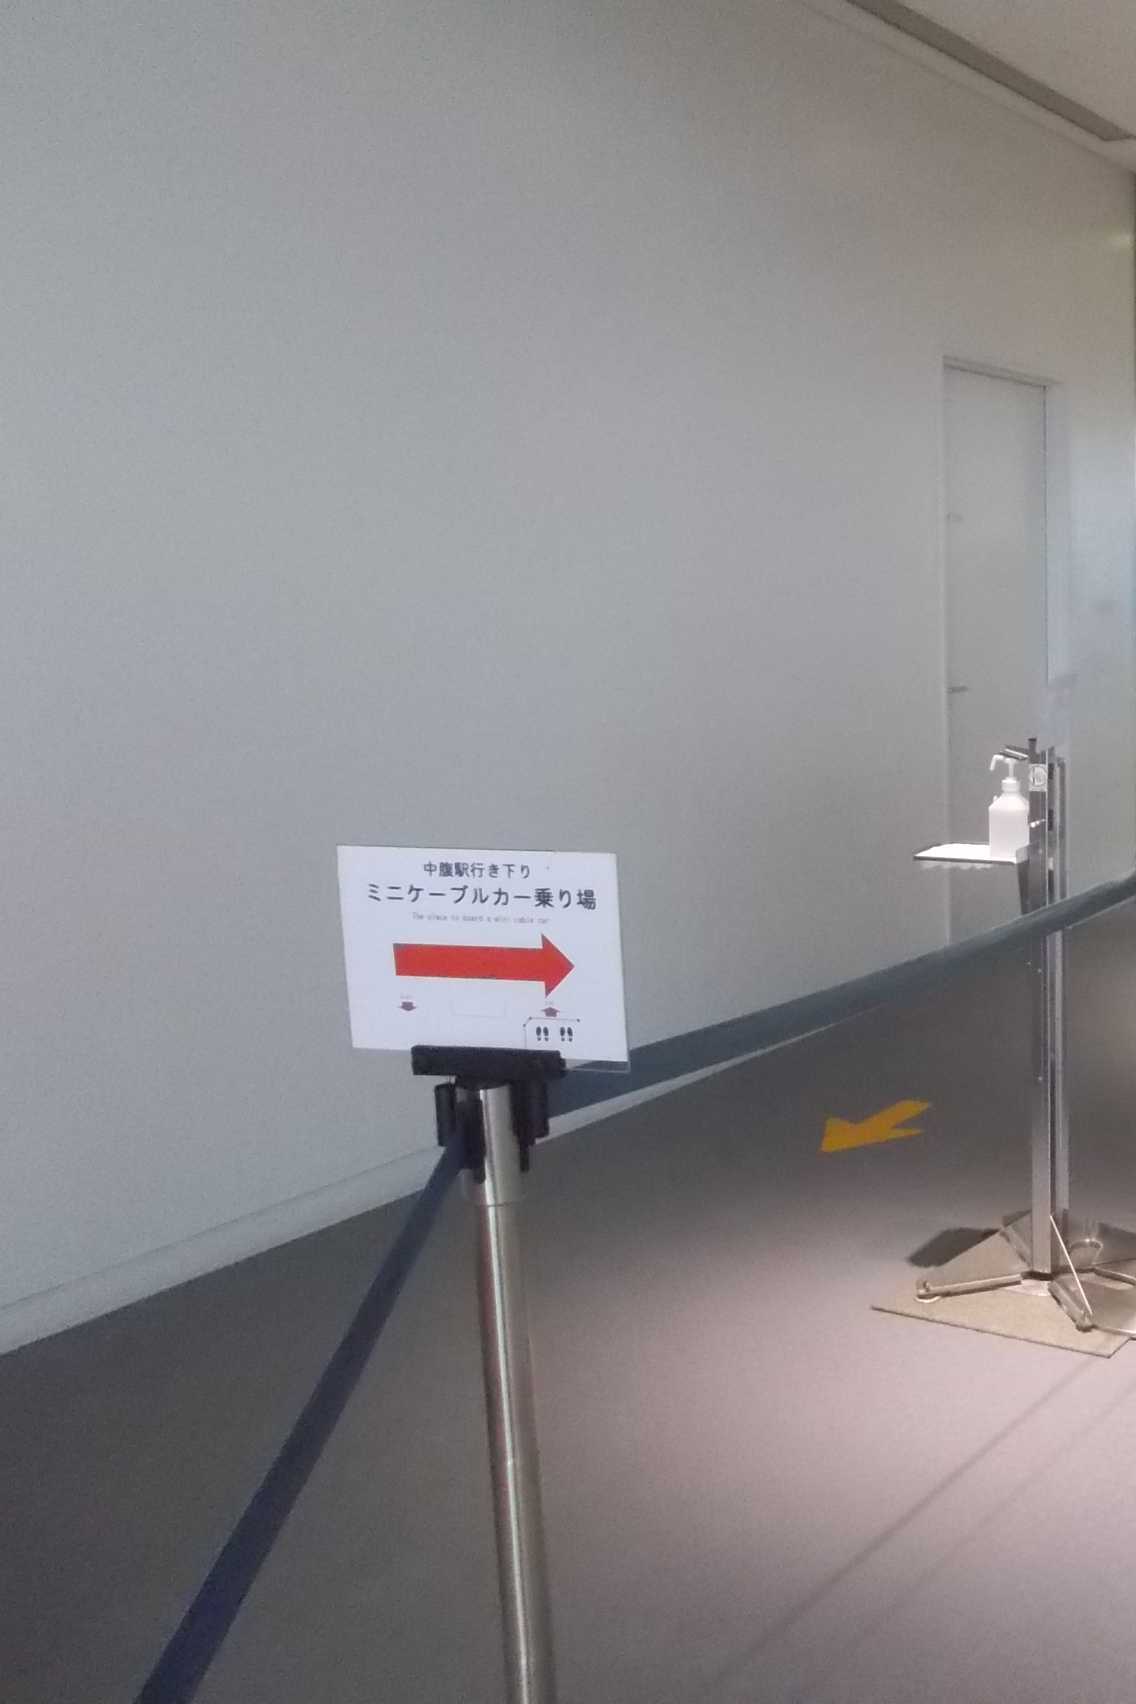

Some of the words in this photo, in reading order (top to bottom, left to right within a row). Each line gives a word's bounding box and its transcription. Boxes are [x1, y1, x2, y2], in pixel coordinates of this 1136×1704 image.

[424, 861, 531, 879] 中腹駅行き下り
[367, 884, 597, 910] ミニケーブルカー乗り場
